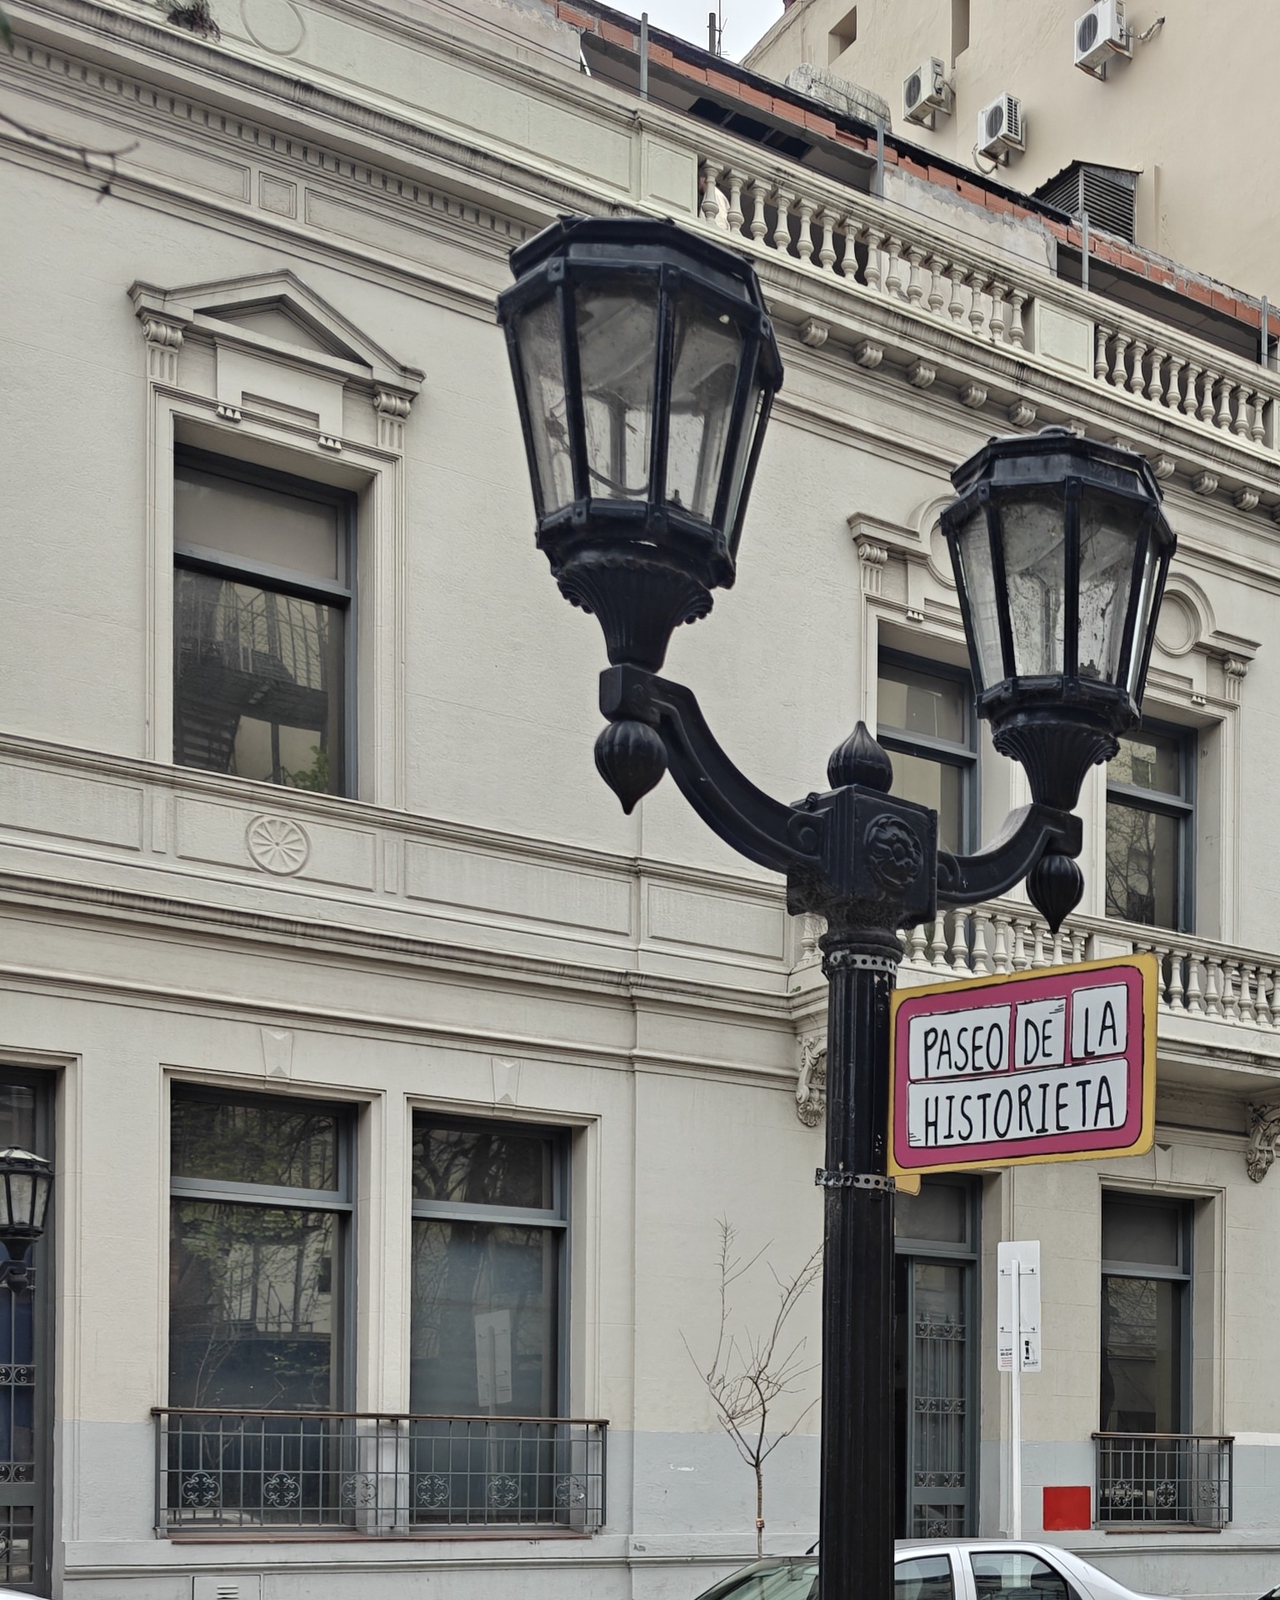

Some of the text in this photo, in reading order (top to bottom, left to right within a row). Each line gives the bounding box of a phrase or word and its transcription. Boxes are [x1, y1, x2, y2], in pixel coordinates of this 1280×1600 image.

[924, 1000, 1118, 1078] PASEO DE LA
[925, 1075, 1115, 1146] HISTORIETA
